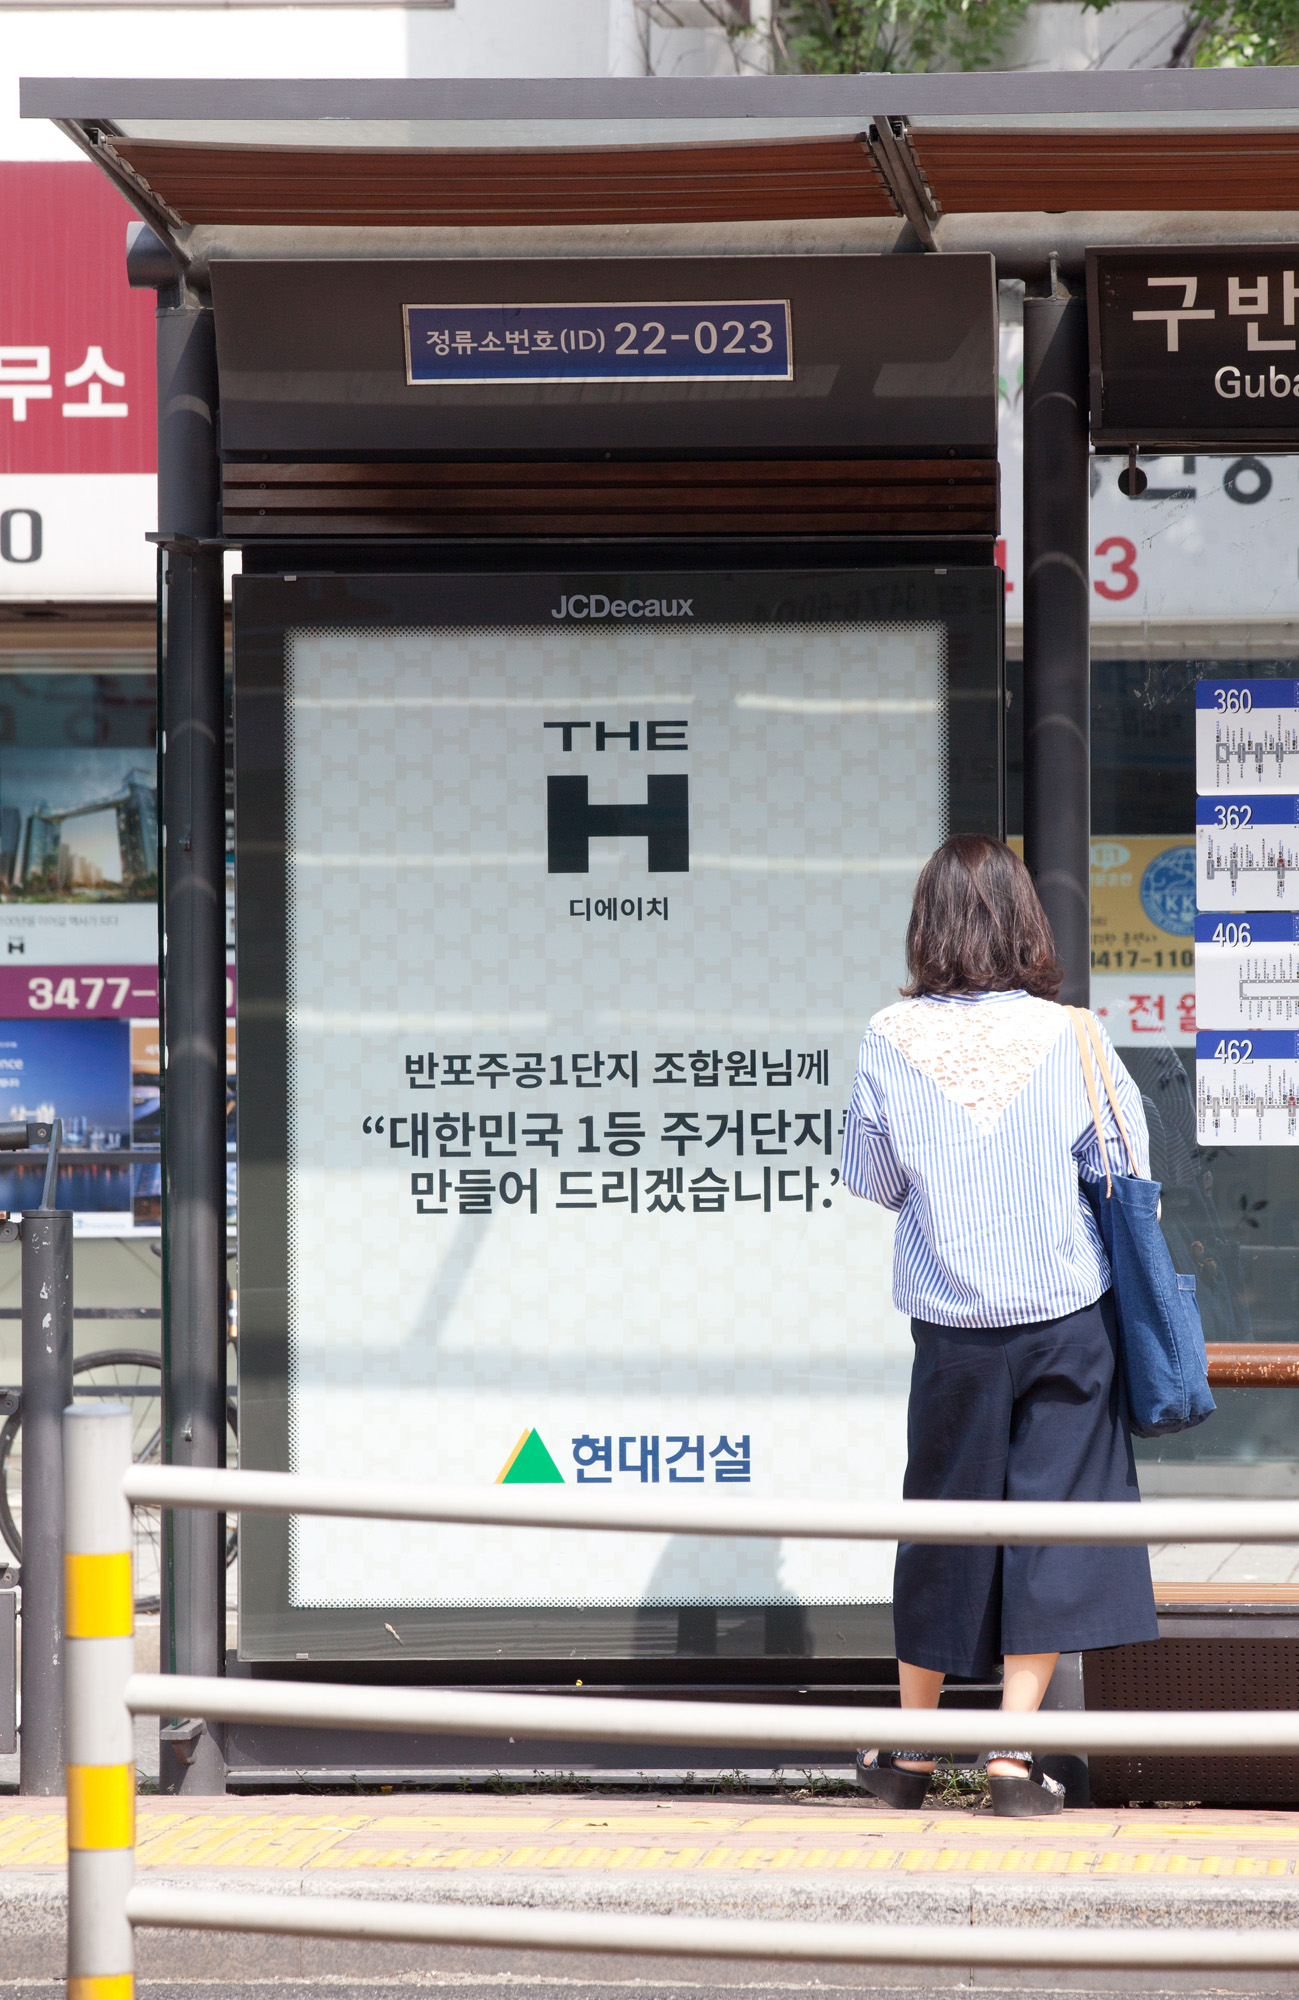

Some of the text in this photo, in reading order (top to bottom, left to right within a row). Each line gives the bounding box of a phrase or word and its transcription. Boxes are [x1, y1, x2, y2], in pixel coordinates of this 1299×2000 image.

[1132, 270, 1299, 352] 구반
[426, 320, 774, 356] 정류소번호(ID) 22-023
[0, 345, 129, 421] 무소
[551, 594, 694, 619] JCDecaux
[1214, 688, 1253, 714] 360
[543, 720, 689, 751] THE
[547, 774, 690, 873] H
[1214, 805, 1254, 830] 362
[569, 897, 669, 921] 디에이치
[1212, 922, 1252, 947] 406
[405, 1048, 830, 1089] 반포주공1단지 조합원님께
[1214, 1039, 1254, 1064] 462
[362, 1108, 849, 1159] “대한민국 1등 주거단지
[410, 1167, 538, 1215] 만들어
[571, 1434, 751, 1484] 현대건설
